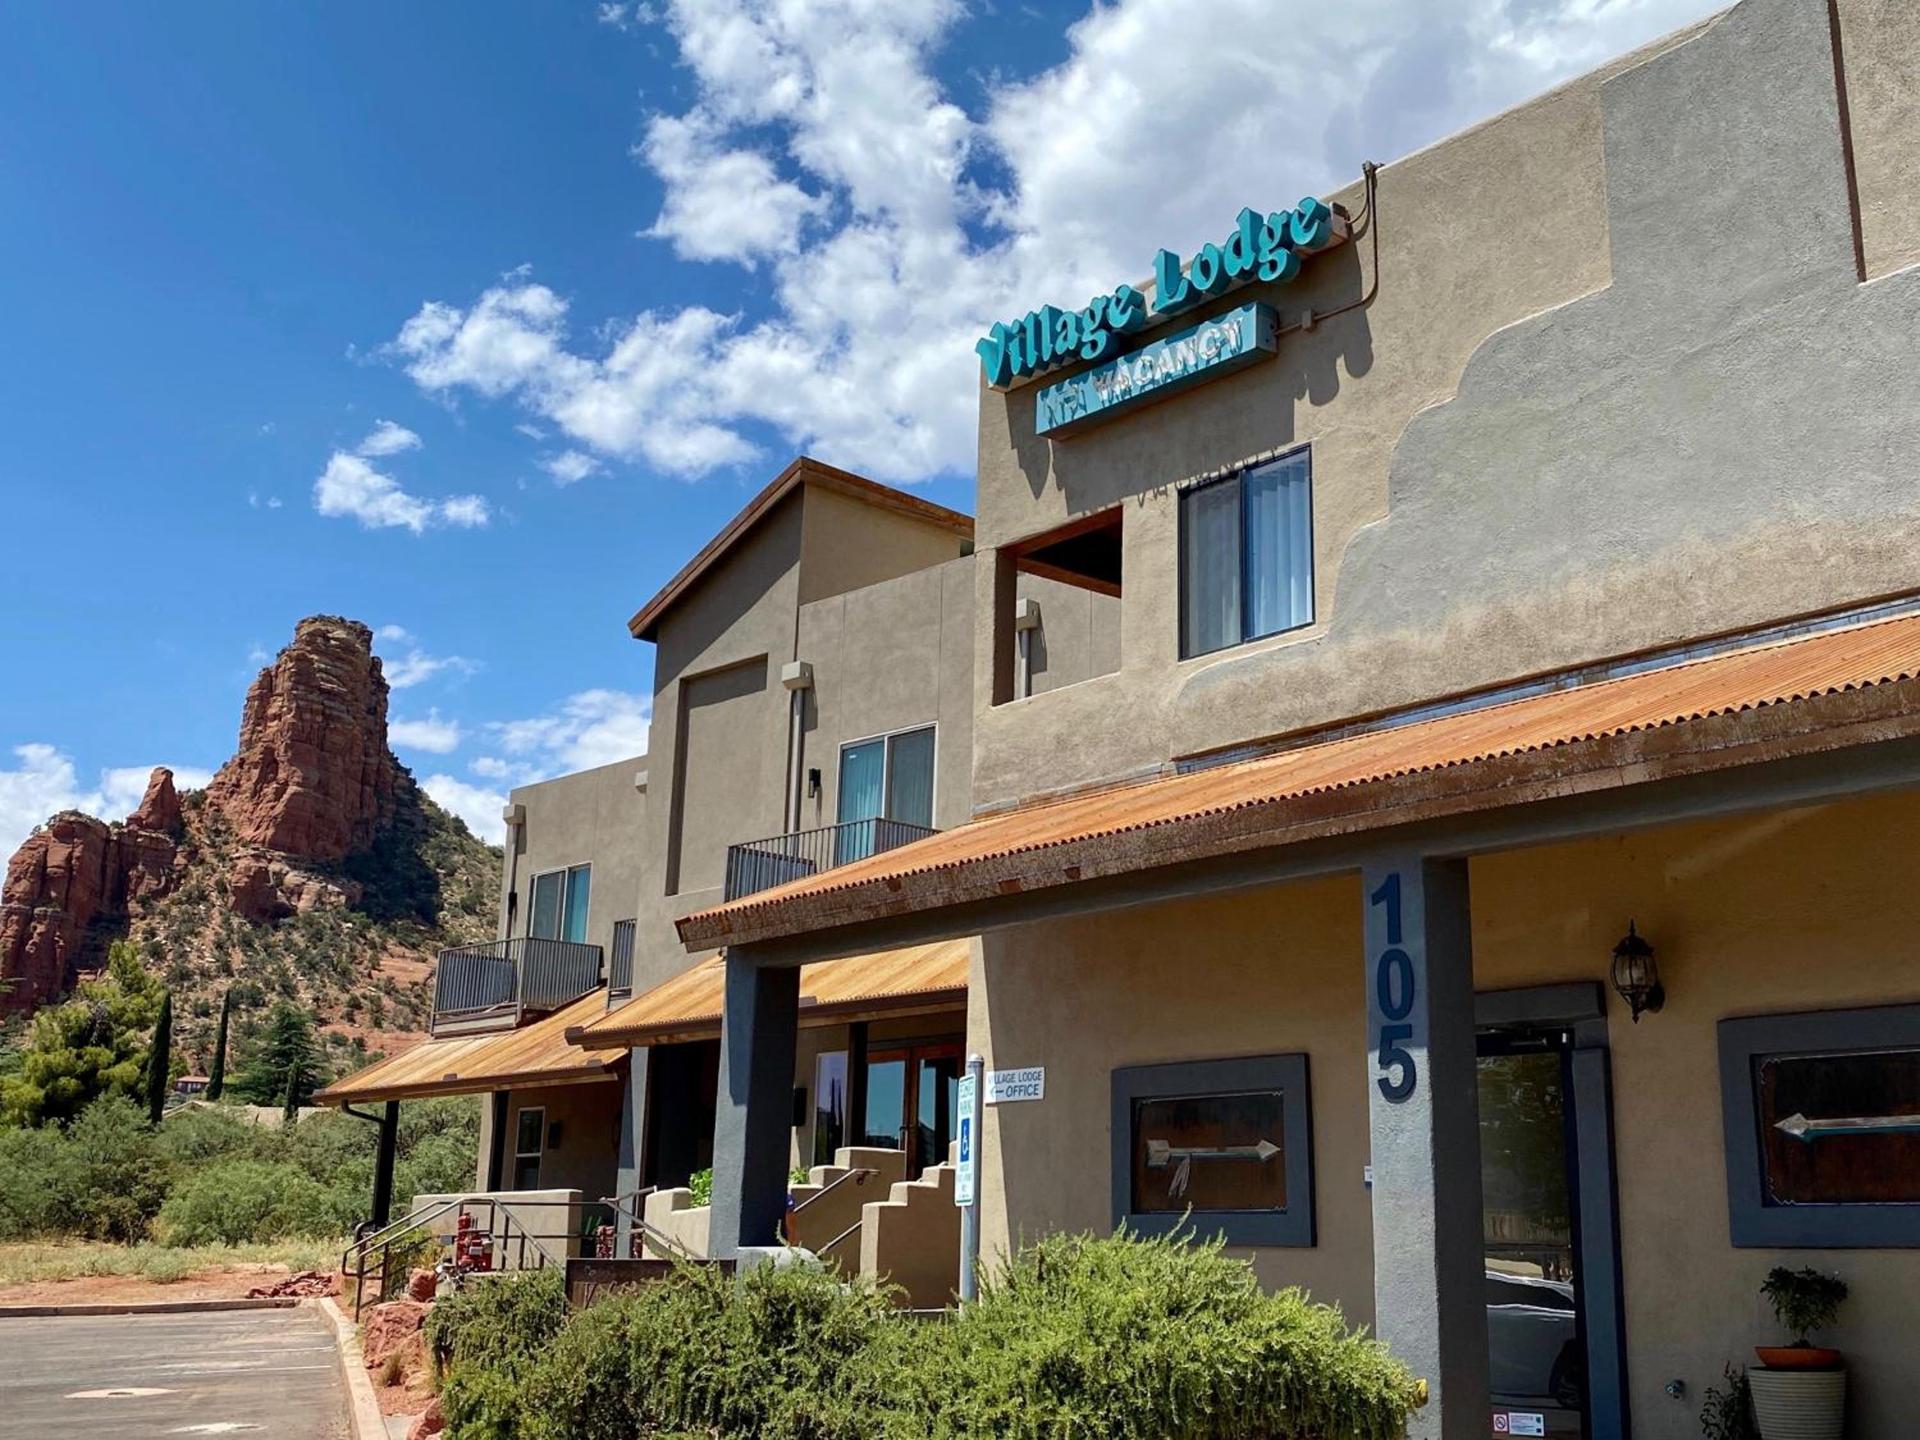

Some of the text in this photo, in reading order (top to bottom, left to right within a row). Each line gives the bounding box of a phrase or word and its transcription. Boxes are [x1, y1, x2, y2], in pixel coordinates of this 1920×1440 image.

[976, 197, 1330, 386] Village Lodge
[1094, 317, 1243, 399] VACANCY
[1371, 872, 1417, 1104] 105
[1006, 1084, 1039, 1097] OFFICE
[1018, 1070, 1043, 1083] LODGE
